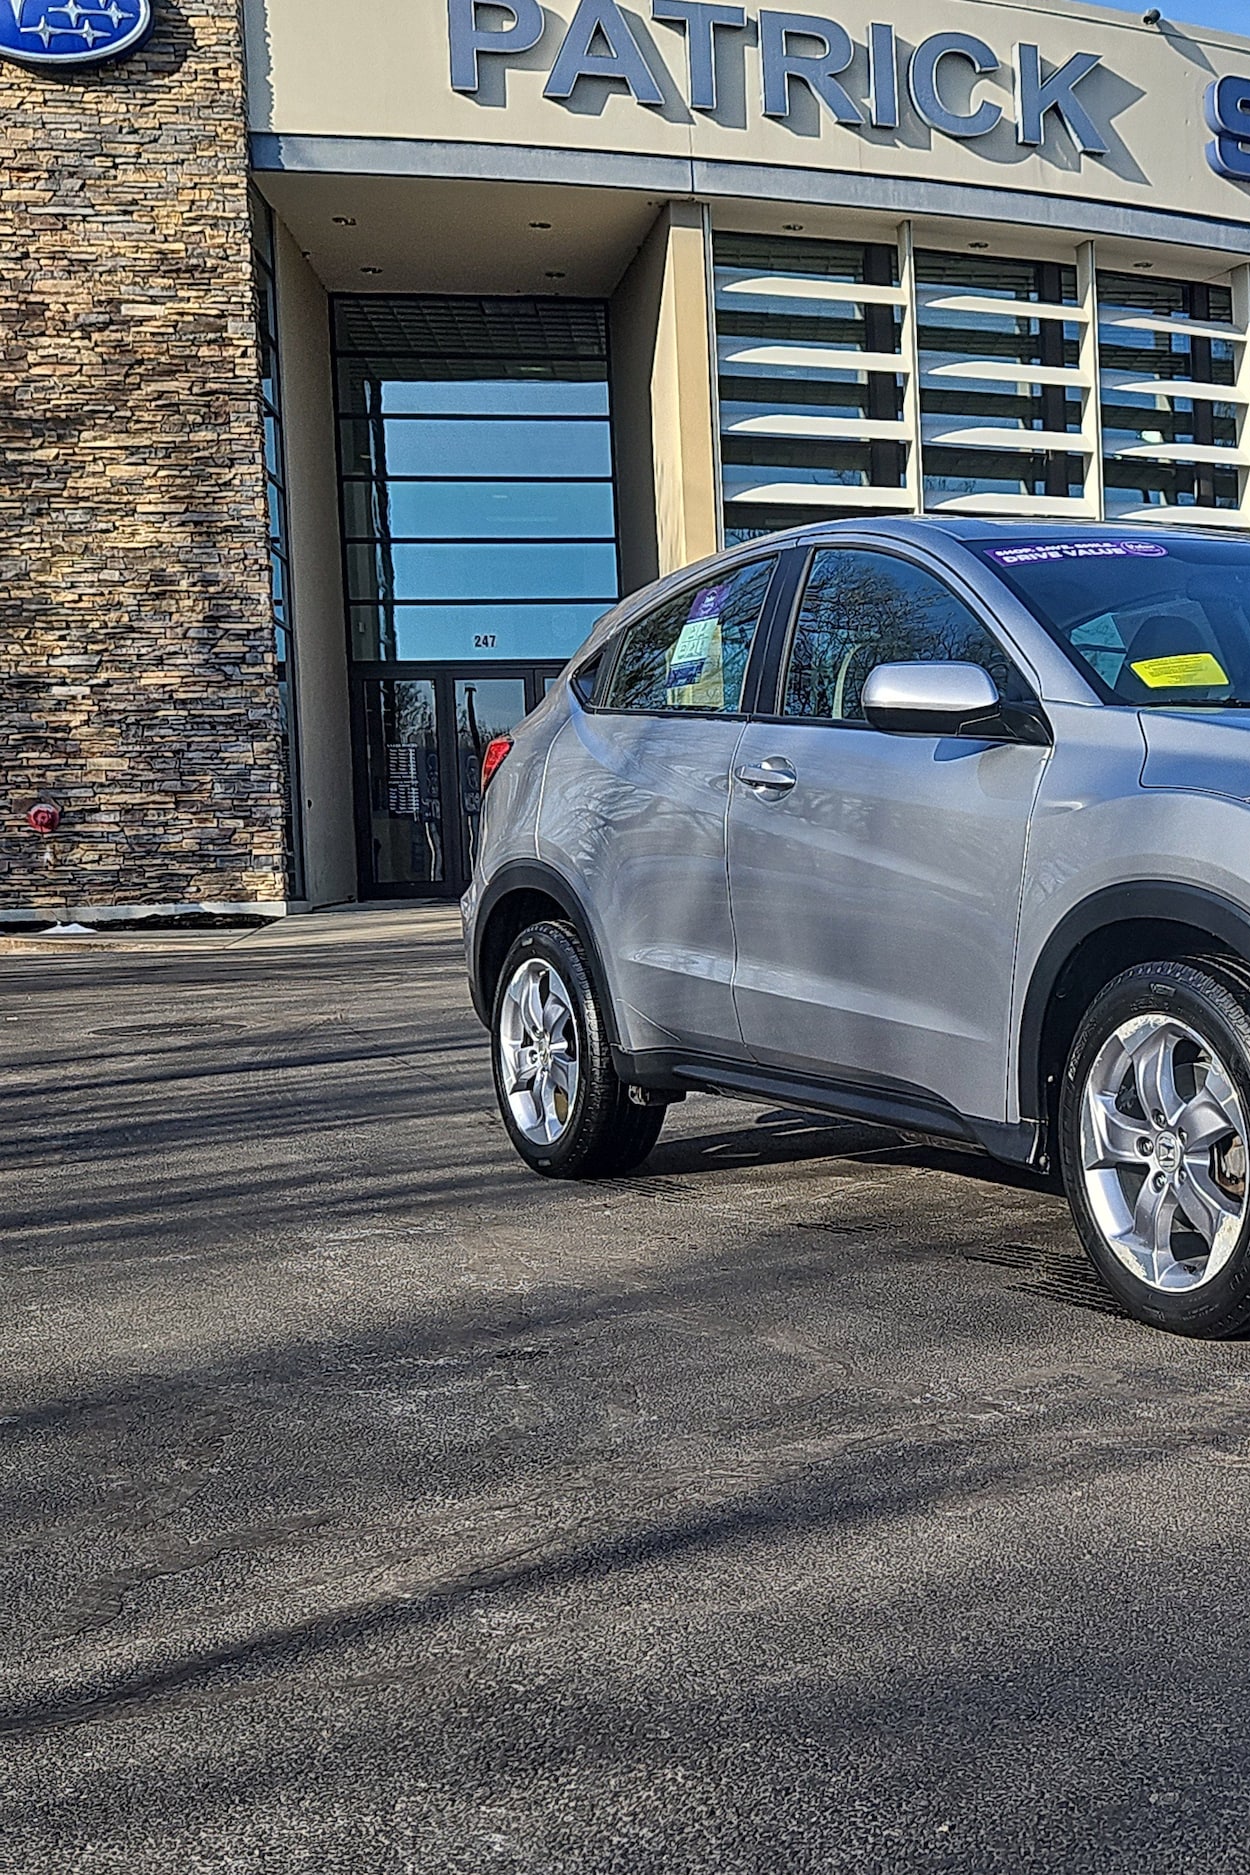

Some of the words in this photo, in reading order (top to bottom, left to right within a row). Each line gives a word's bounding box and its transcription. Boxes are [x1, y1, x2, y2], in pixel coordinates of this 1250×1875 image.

[447, 0, 1109, 154] PATRICK
[1003, 551, 1063, 563] DRIVE
[1063, 547, 1127, 558] VALUE
[474, 635, 497, 648] 247
